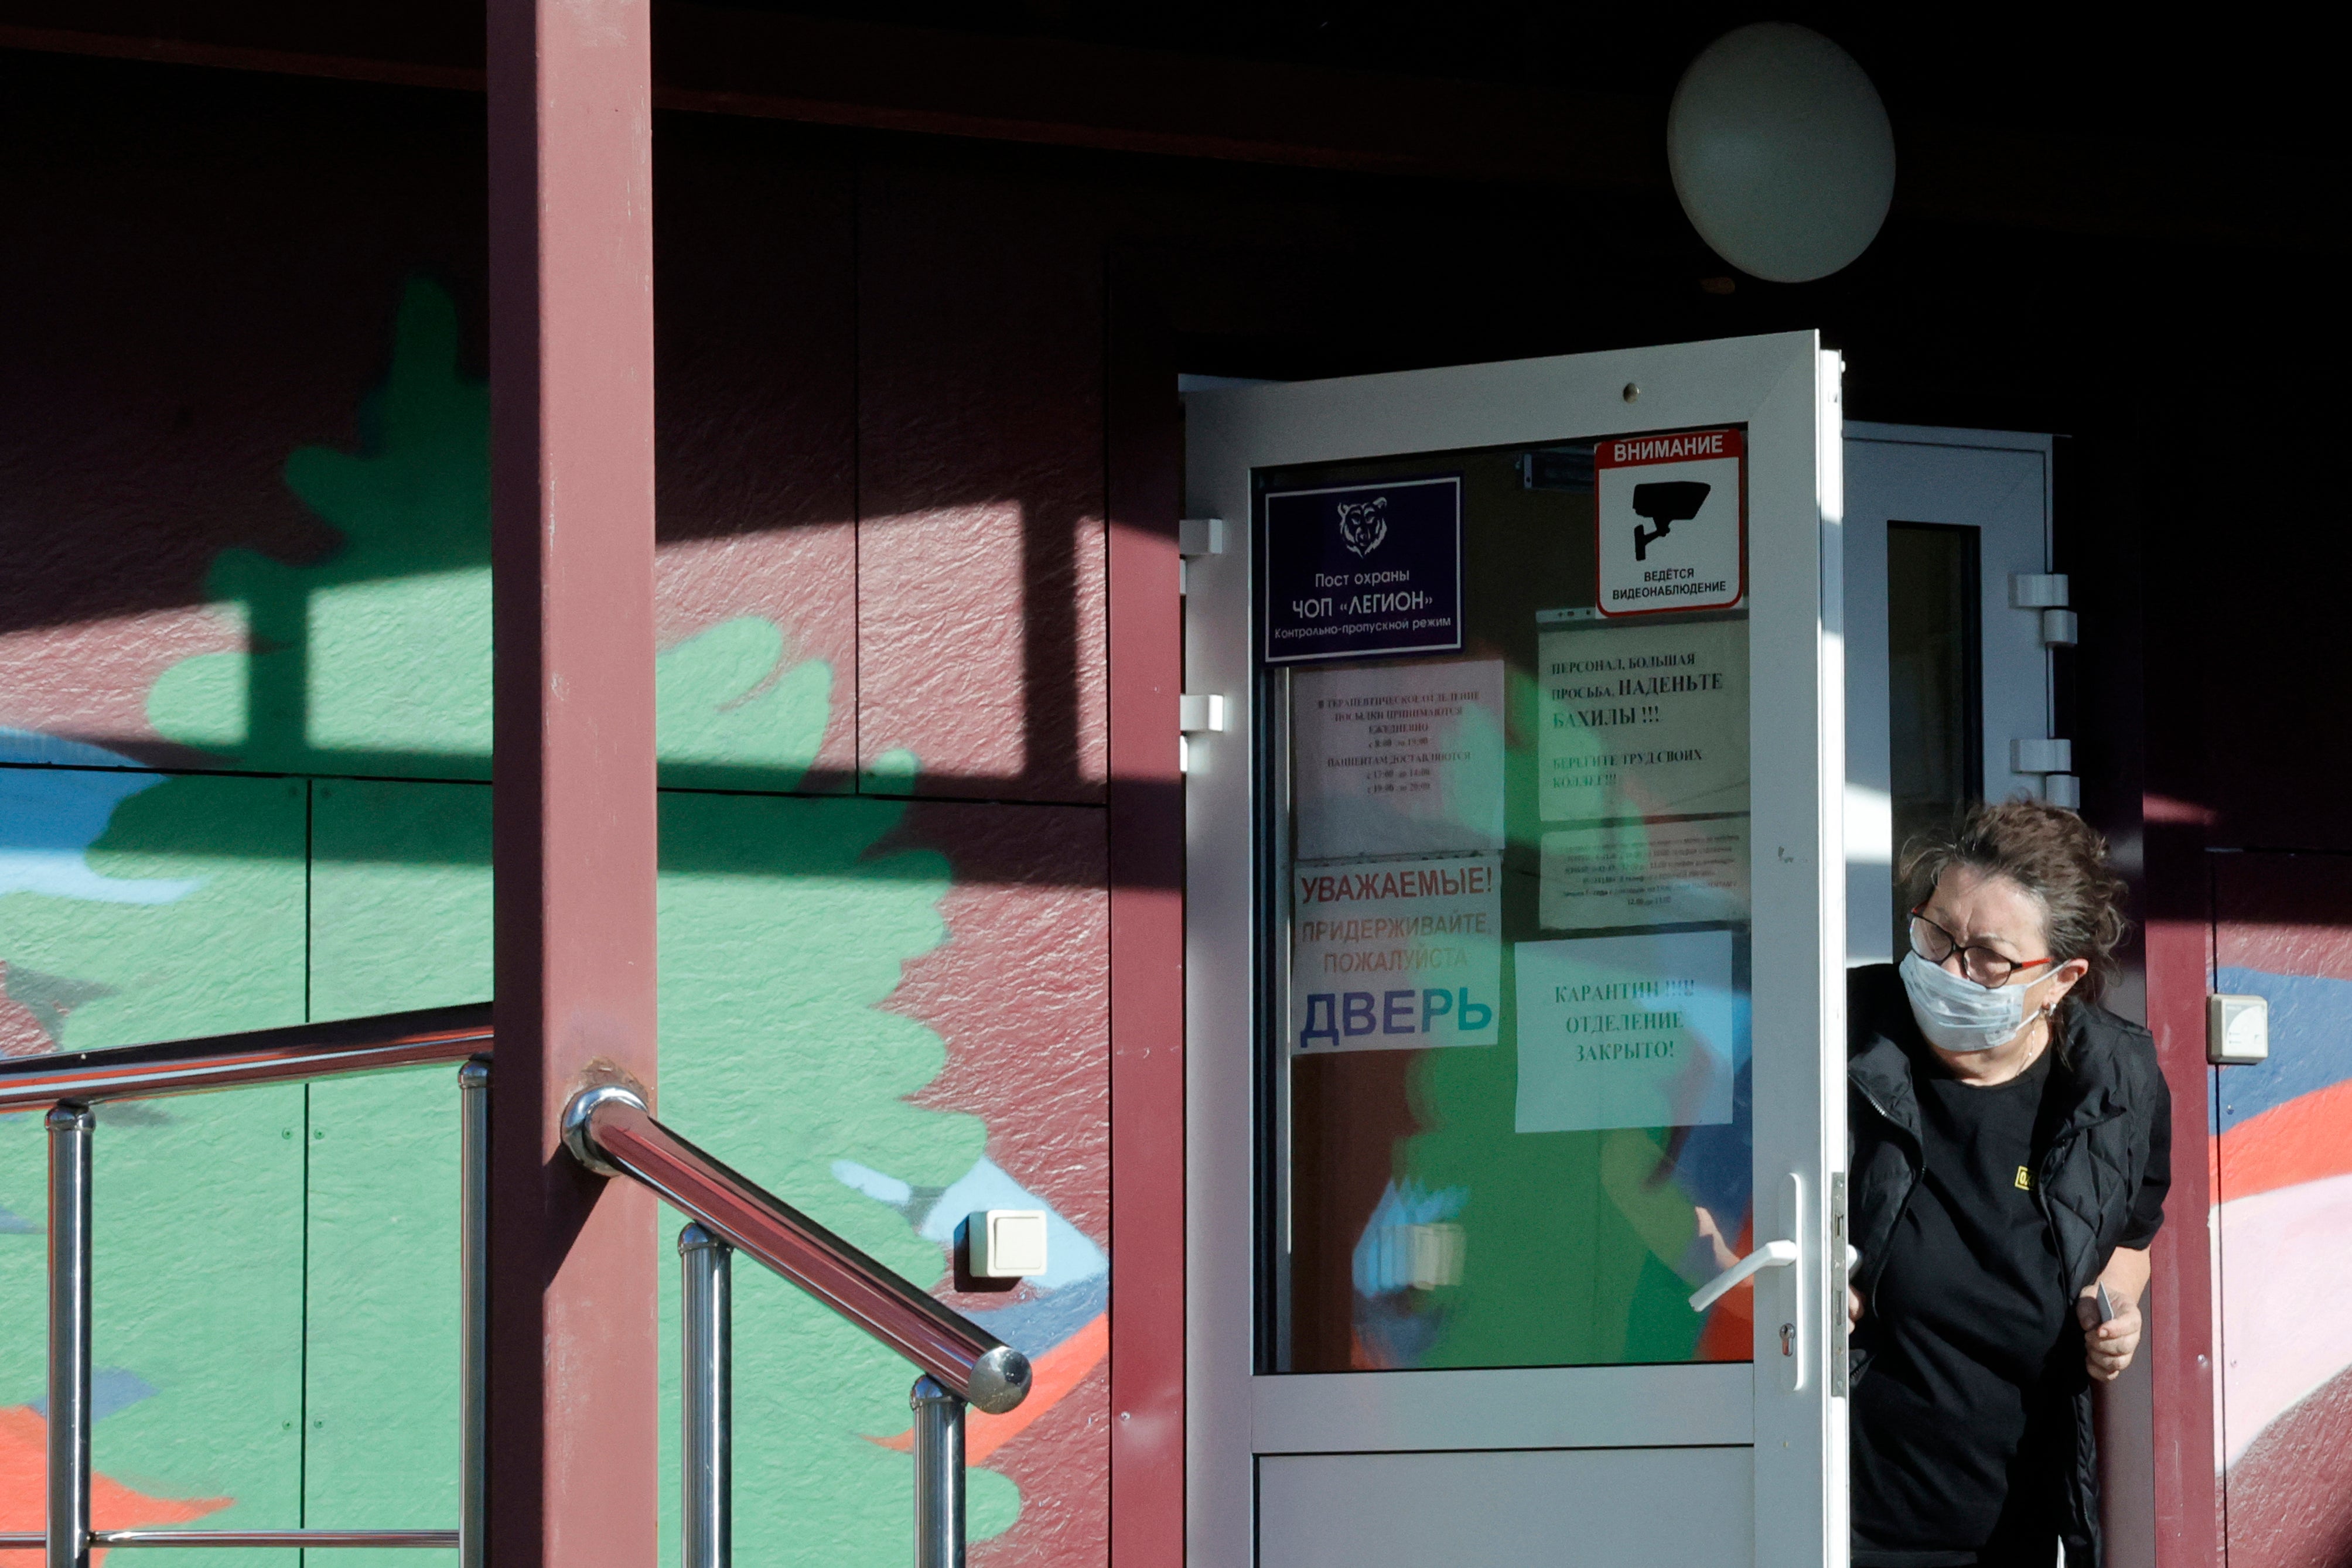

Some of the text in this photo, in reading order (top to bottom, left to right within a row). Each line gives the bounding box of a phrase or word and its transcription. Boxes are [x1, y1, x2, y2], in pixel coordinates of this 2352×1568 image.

[1614, 435, 1723, 462] ВНИМАНИЕ
[1315, 570, 1409, 587] Пост охраны
[1644, 568, 1694, 582] ВЕДЁТСЯ
[1612, 580, 1726, 600] ВИДЕОНАБЛЮДЕНИЕ
[1292, 590, 1433, 619] ЧОП «ЛЕГИОН»
[1275, 617, 1452, 639] Контрольно-пропускной режим
[1629, 652, 1696, 669] БОЛЬШАЯ
[1619, 672, 1724, 696] НАДЕНЬТЕ
[1553, 707, 1637, 729] БАХИЛЫ
[1301, 867, 1492, 904] УВАЖАЕМЫЕ!
[1324, 943, 1468, 973] ПОЖАЛУЙСТА
[1555, 981, 1659, 1003] КАРАНТИН
[1300, 986, 1492, 1048] ДВЕРЬ
[1565, 1011, 1684, 1034] ОТДЕЛЕНИЕ
[1576, 1040, 1674, 1062] ЗАКРЫТО!
